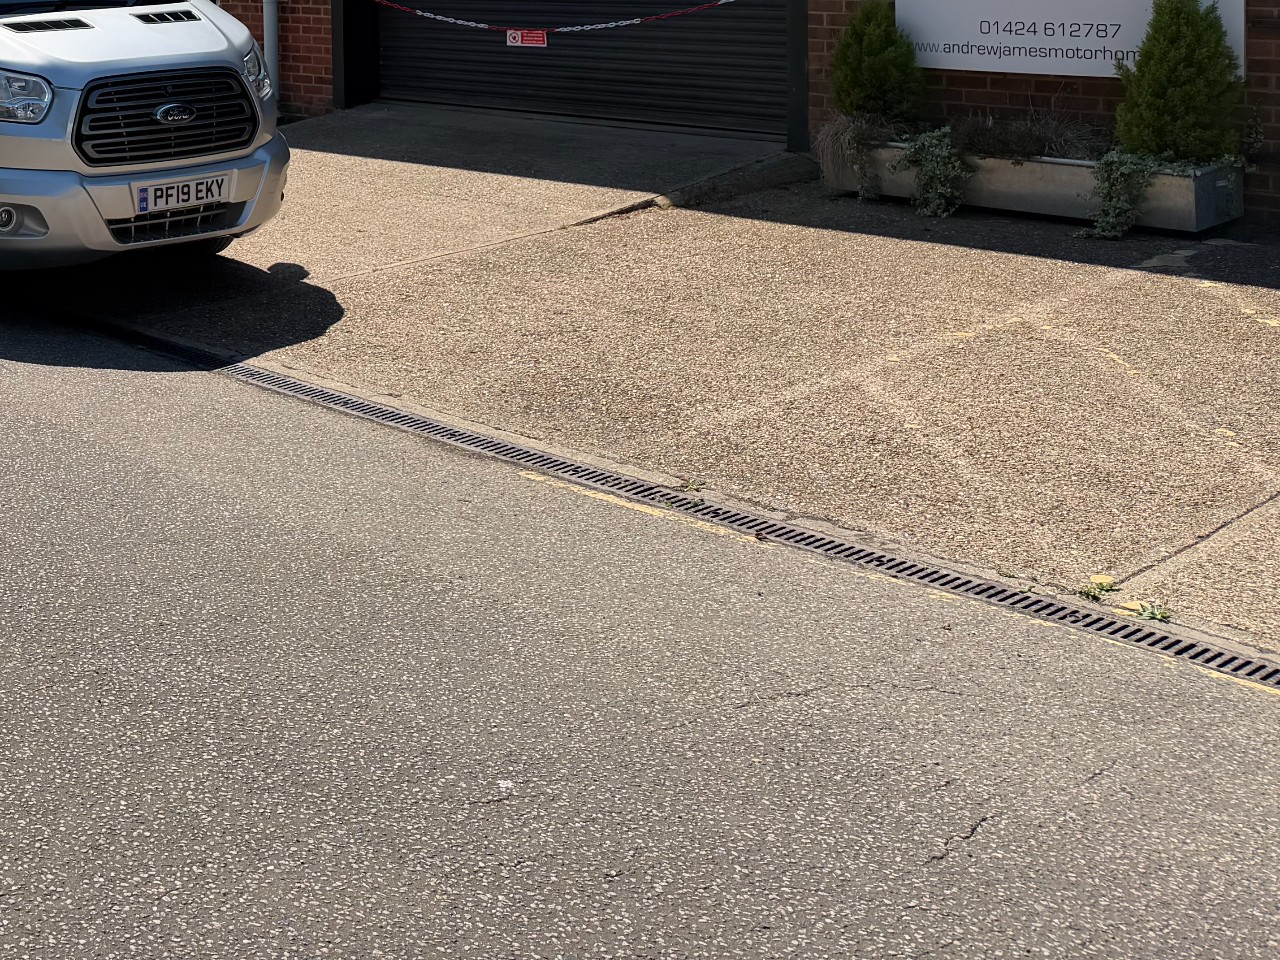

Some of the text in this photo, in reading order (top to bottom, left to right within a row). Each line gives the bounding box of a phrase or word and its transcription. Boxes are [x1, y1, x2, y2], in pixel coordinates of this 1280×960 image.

[979, 20, 1122, 38] 01424 612787
[153, 178, 225, 207] PF19 EKY
